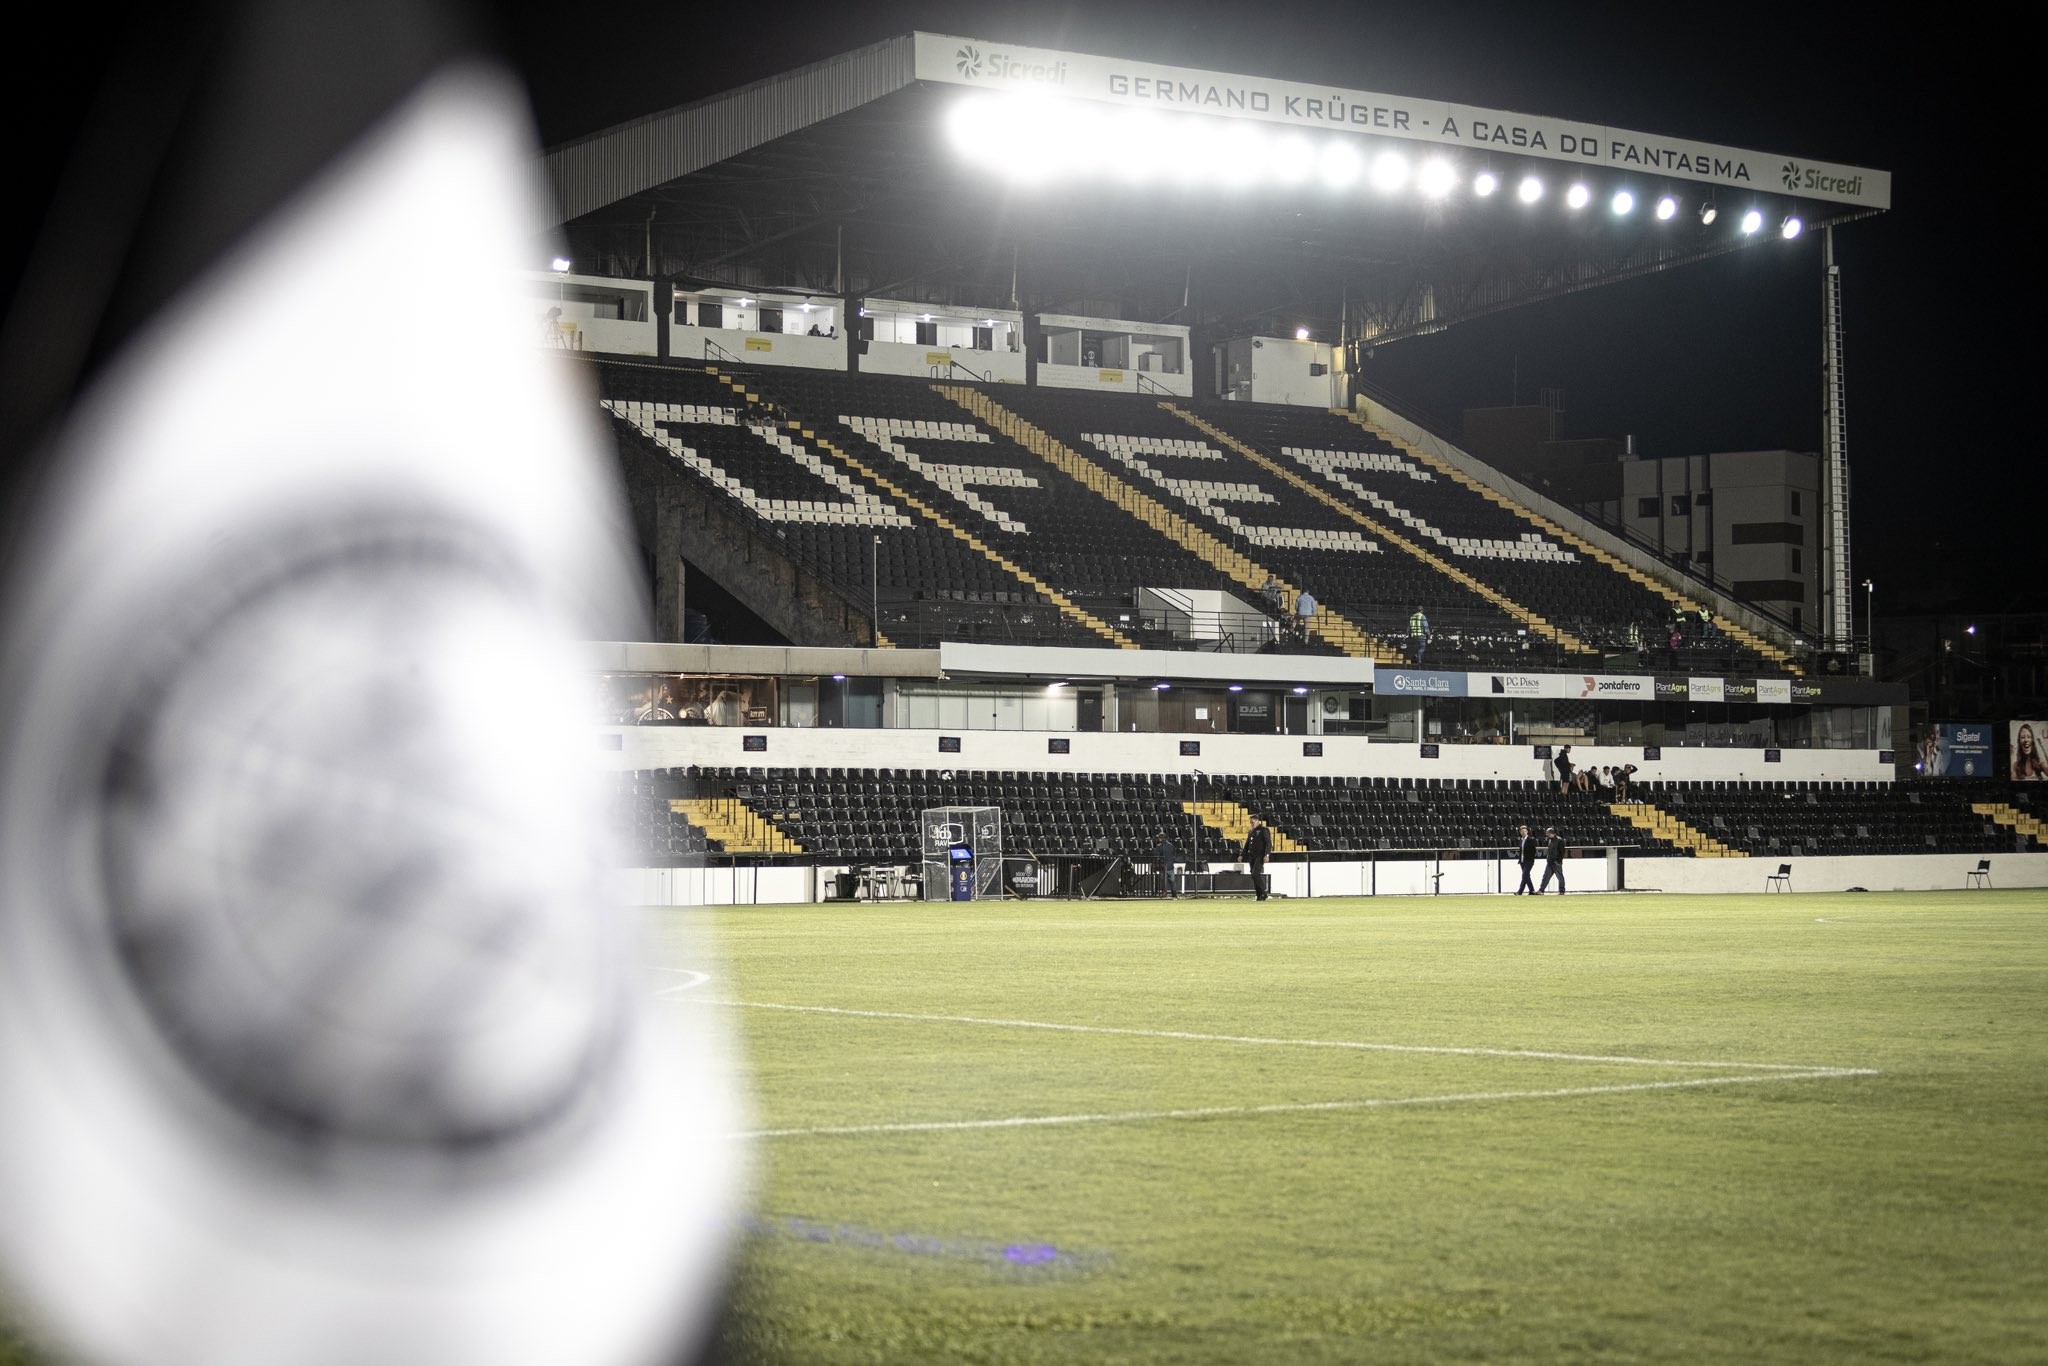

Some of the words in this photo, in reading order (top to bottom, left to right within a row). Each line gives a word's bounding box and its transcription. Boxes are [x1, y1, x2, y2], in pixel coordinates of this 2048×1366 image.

[988, 53, 1067, 85] Sicredi
[1109, 74, 1270, 112] GERMANO
[1285, 94, 1410, 131] KRÜGER
[1441, 117, 1460, 138] A
[1472, 121, 1548, 150] CASA
[1560, 134, 1598, 157] DO
[1611, 141, 1751, 182] FANTASMA
[1804, 168, 1862, 196] Sicredi
[1405, 676, 1427, 687] Santa
[1428, 676, 1449, 688] Clara
[1506, 677, 1519, 686] PG
[1520, 677, 1540, 687] Pisos
[1598, 680, 1641, 692] pontaferro
[1956, 729, 1981, 743] Sigatel
